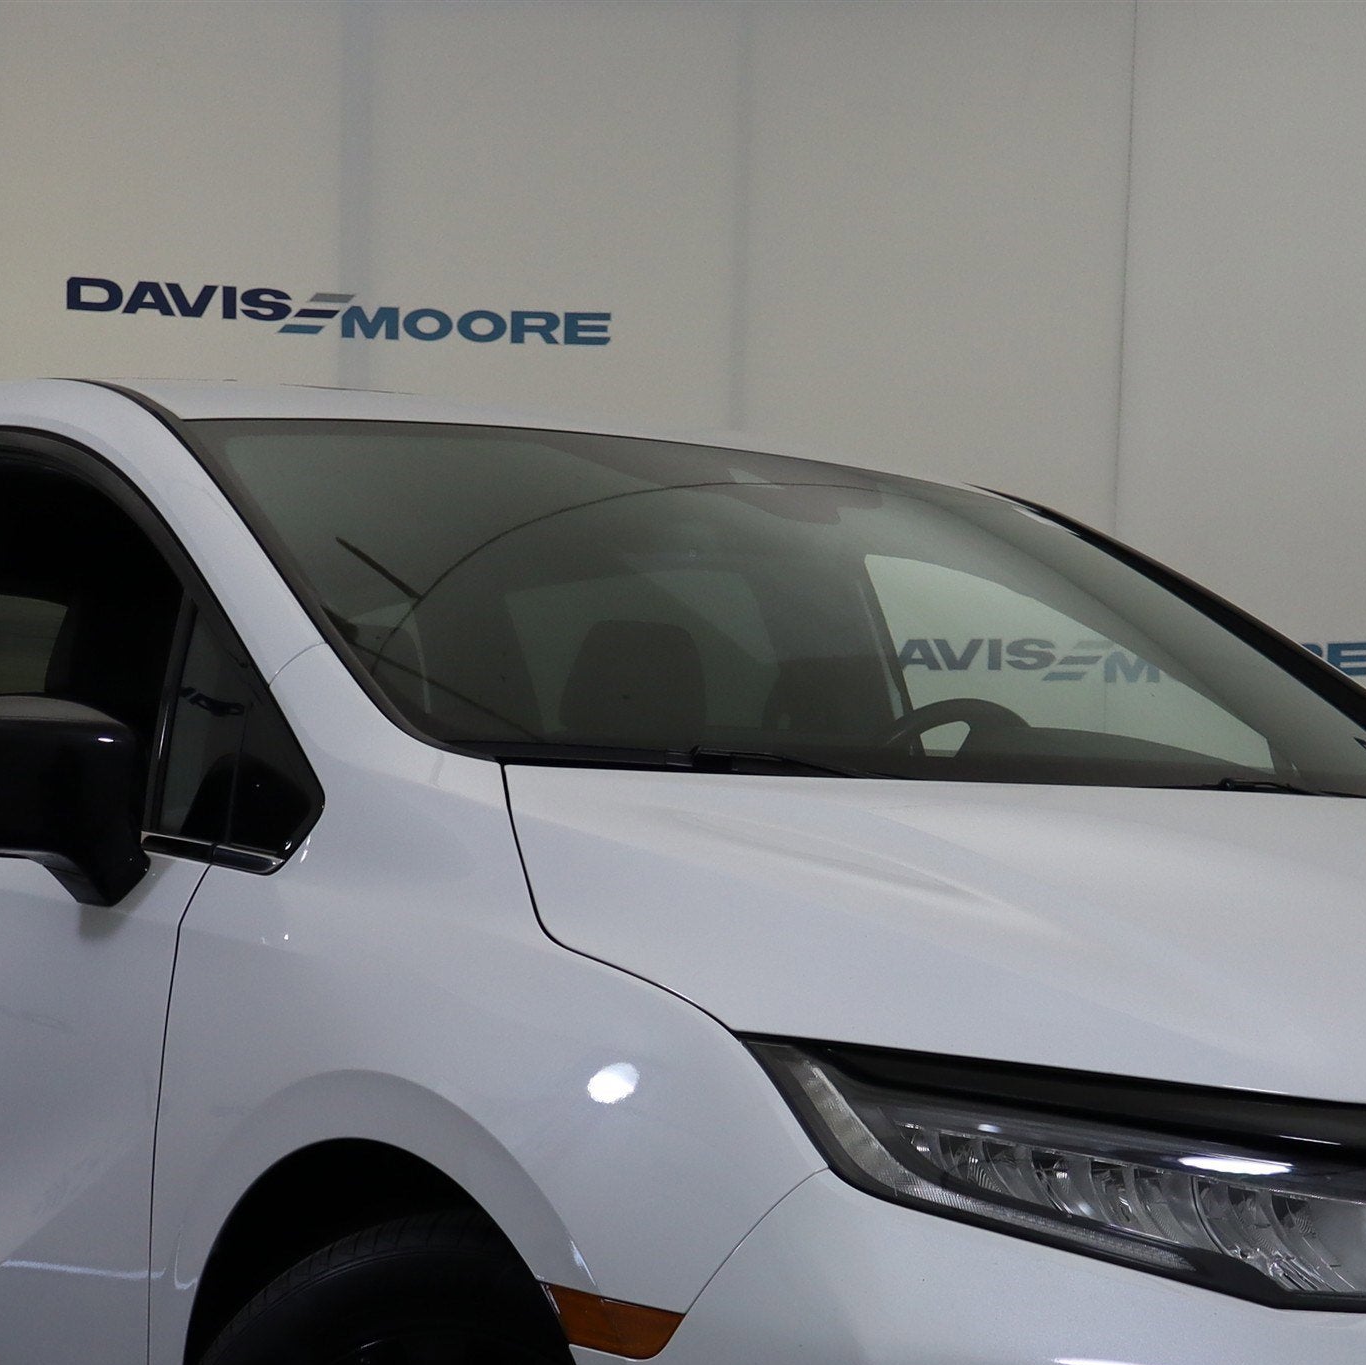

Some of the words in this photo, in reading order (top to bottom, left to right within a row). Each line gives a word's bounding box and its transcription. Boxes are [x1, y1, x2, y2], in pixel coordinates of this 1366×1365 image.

[66, 276, 292, 322] DAVIS
[341, 305, 612, 346] MOORE
[897, 637, 1056, 671] AVIS
